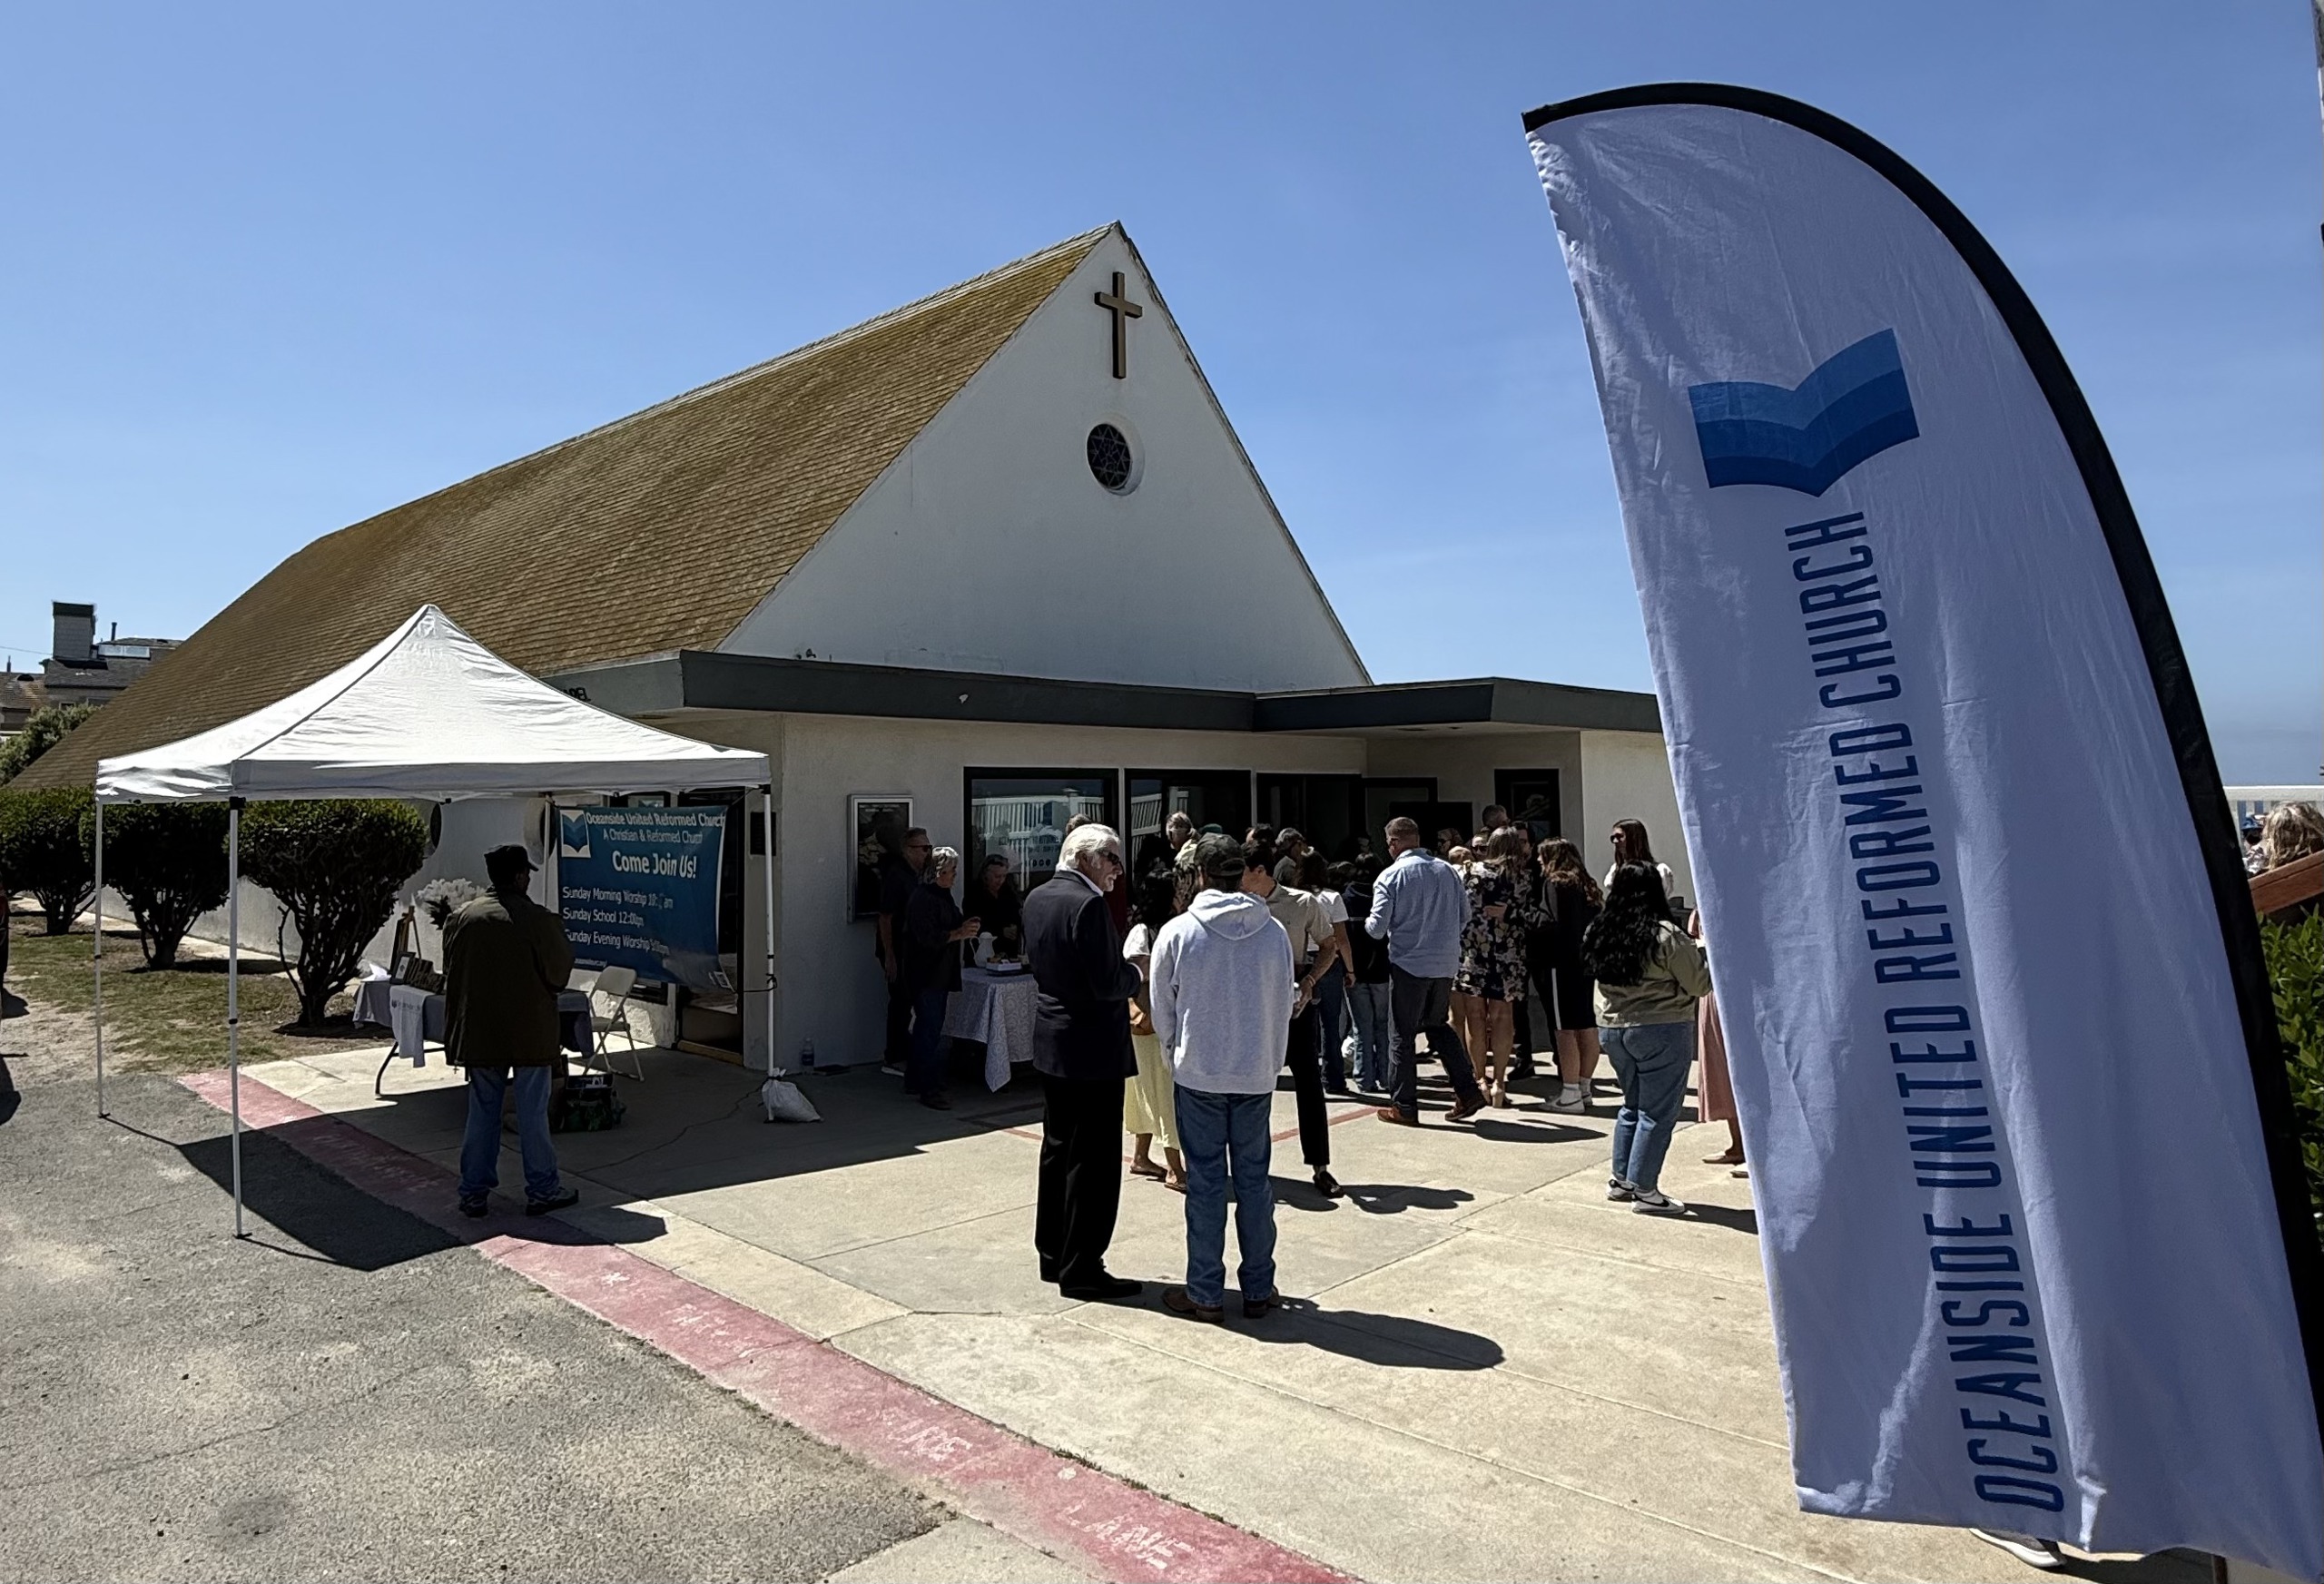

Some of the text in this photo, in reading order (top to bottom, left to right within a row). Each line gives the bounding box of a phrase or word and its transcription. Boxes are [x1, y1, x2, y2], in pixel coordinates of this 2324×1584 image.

[586, 812, 625, 825] Oceanside
[626, 812, 654, 826] United
[655, 813, 696, 827] Reformed
[604, 831, 609, 841] A
[639, 830, 645, 842] &
[612, 851, 697, 879] Come Join Us!
[563, 887, 591, 901] Sunday
[593, 888, 622, 905] Morning
[563, 908, 591, 922] Sunday
[593, 909, 617, 922] School
[593, 930, 621, 949] Evening
[622, 934, 649, 953] Worship
[1784, 511, 2065, 1513] OCEANSIDE UNITED REFORMED CHURCH
